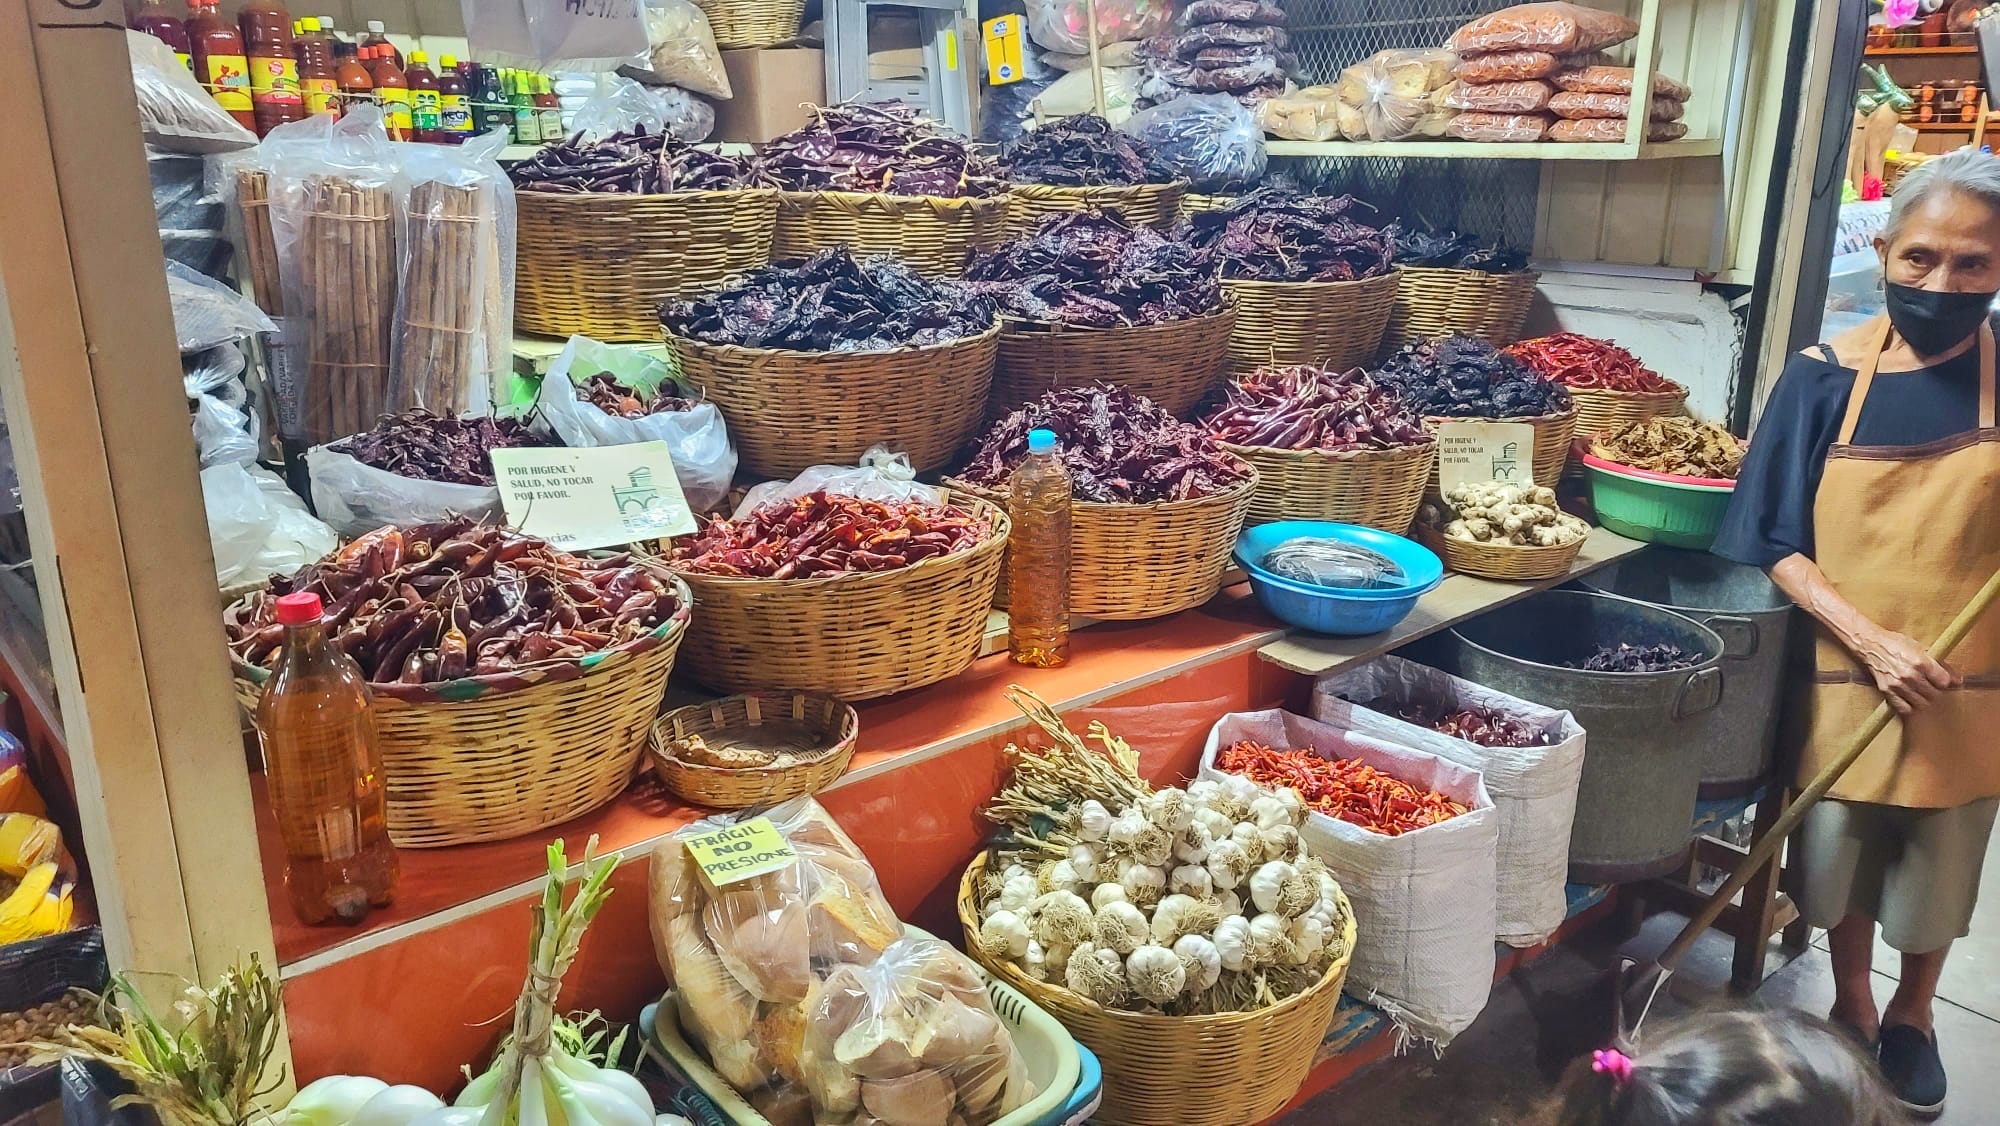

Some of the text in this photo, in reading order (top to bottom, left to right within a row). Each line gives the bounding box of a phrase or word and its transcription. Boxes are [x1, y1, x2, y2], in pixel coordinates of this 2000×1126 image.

[507, 466, 528, 475] POR
[530, 465, 568, 475] HIGIENE
[510, 476, 594, 489] SALUD, NO TOCAR
[514, 490, 571, 500] POR FAVOR.
[712, 841, 752, 856] NO
[704, 848, 796, 876] PRESIONE
